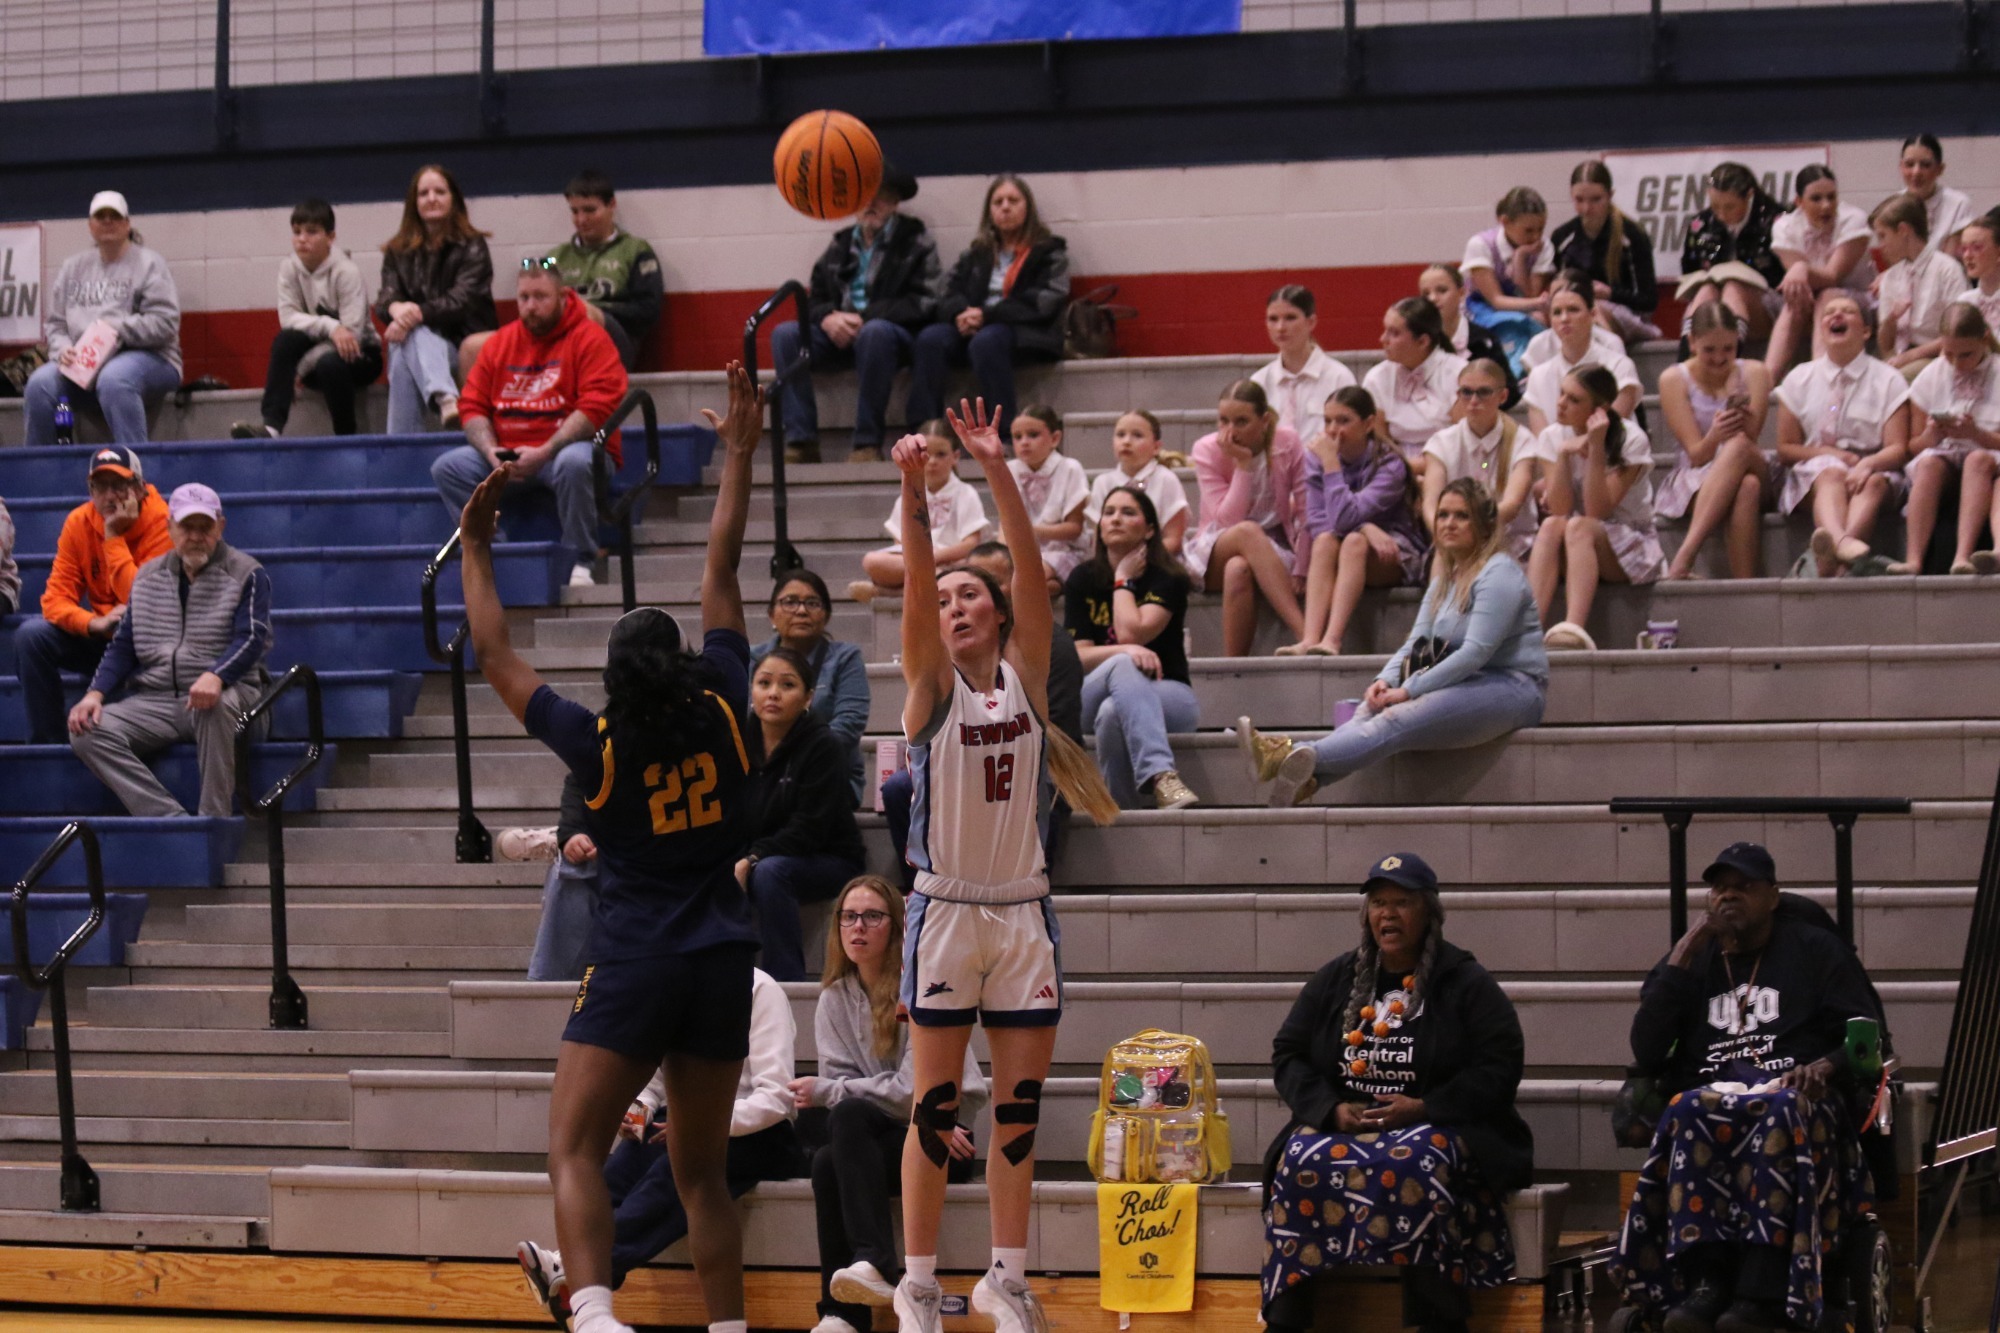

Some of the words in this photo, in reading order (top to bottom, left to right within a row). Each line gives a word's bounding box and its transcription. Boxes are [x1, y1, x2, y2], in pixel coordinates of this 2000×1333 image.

[1635, 170, 1793, 213] GENAL
[643, 752, 722, 835] 22
[984, 753, 1014, 802] 12
[1707, 984, 1780, 1035] UCO
[1344, 1046, 1414, 1063] Central
[1400, 1036, 1415, 1044] OF
[1117, 1185, 1174, 1219] Roll
